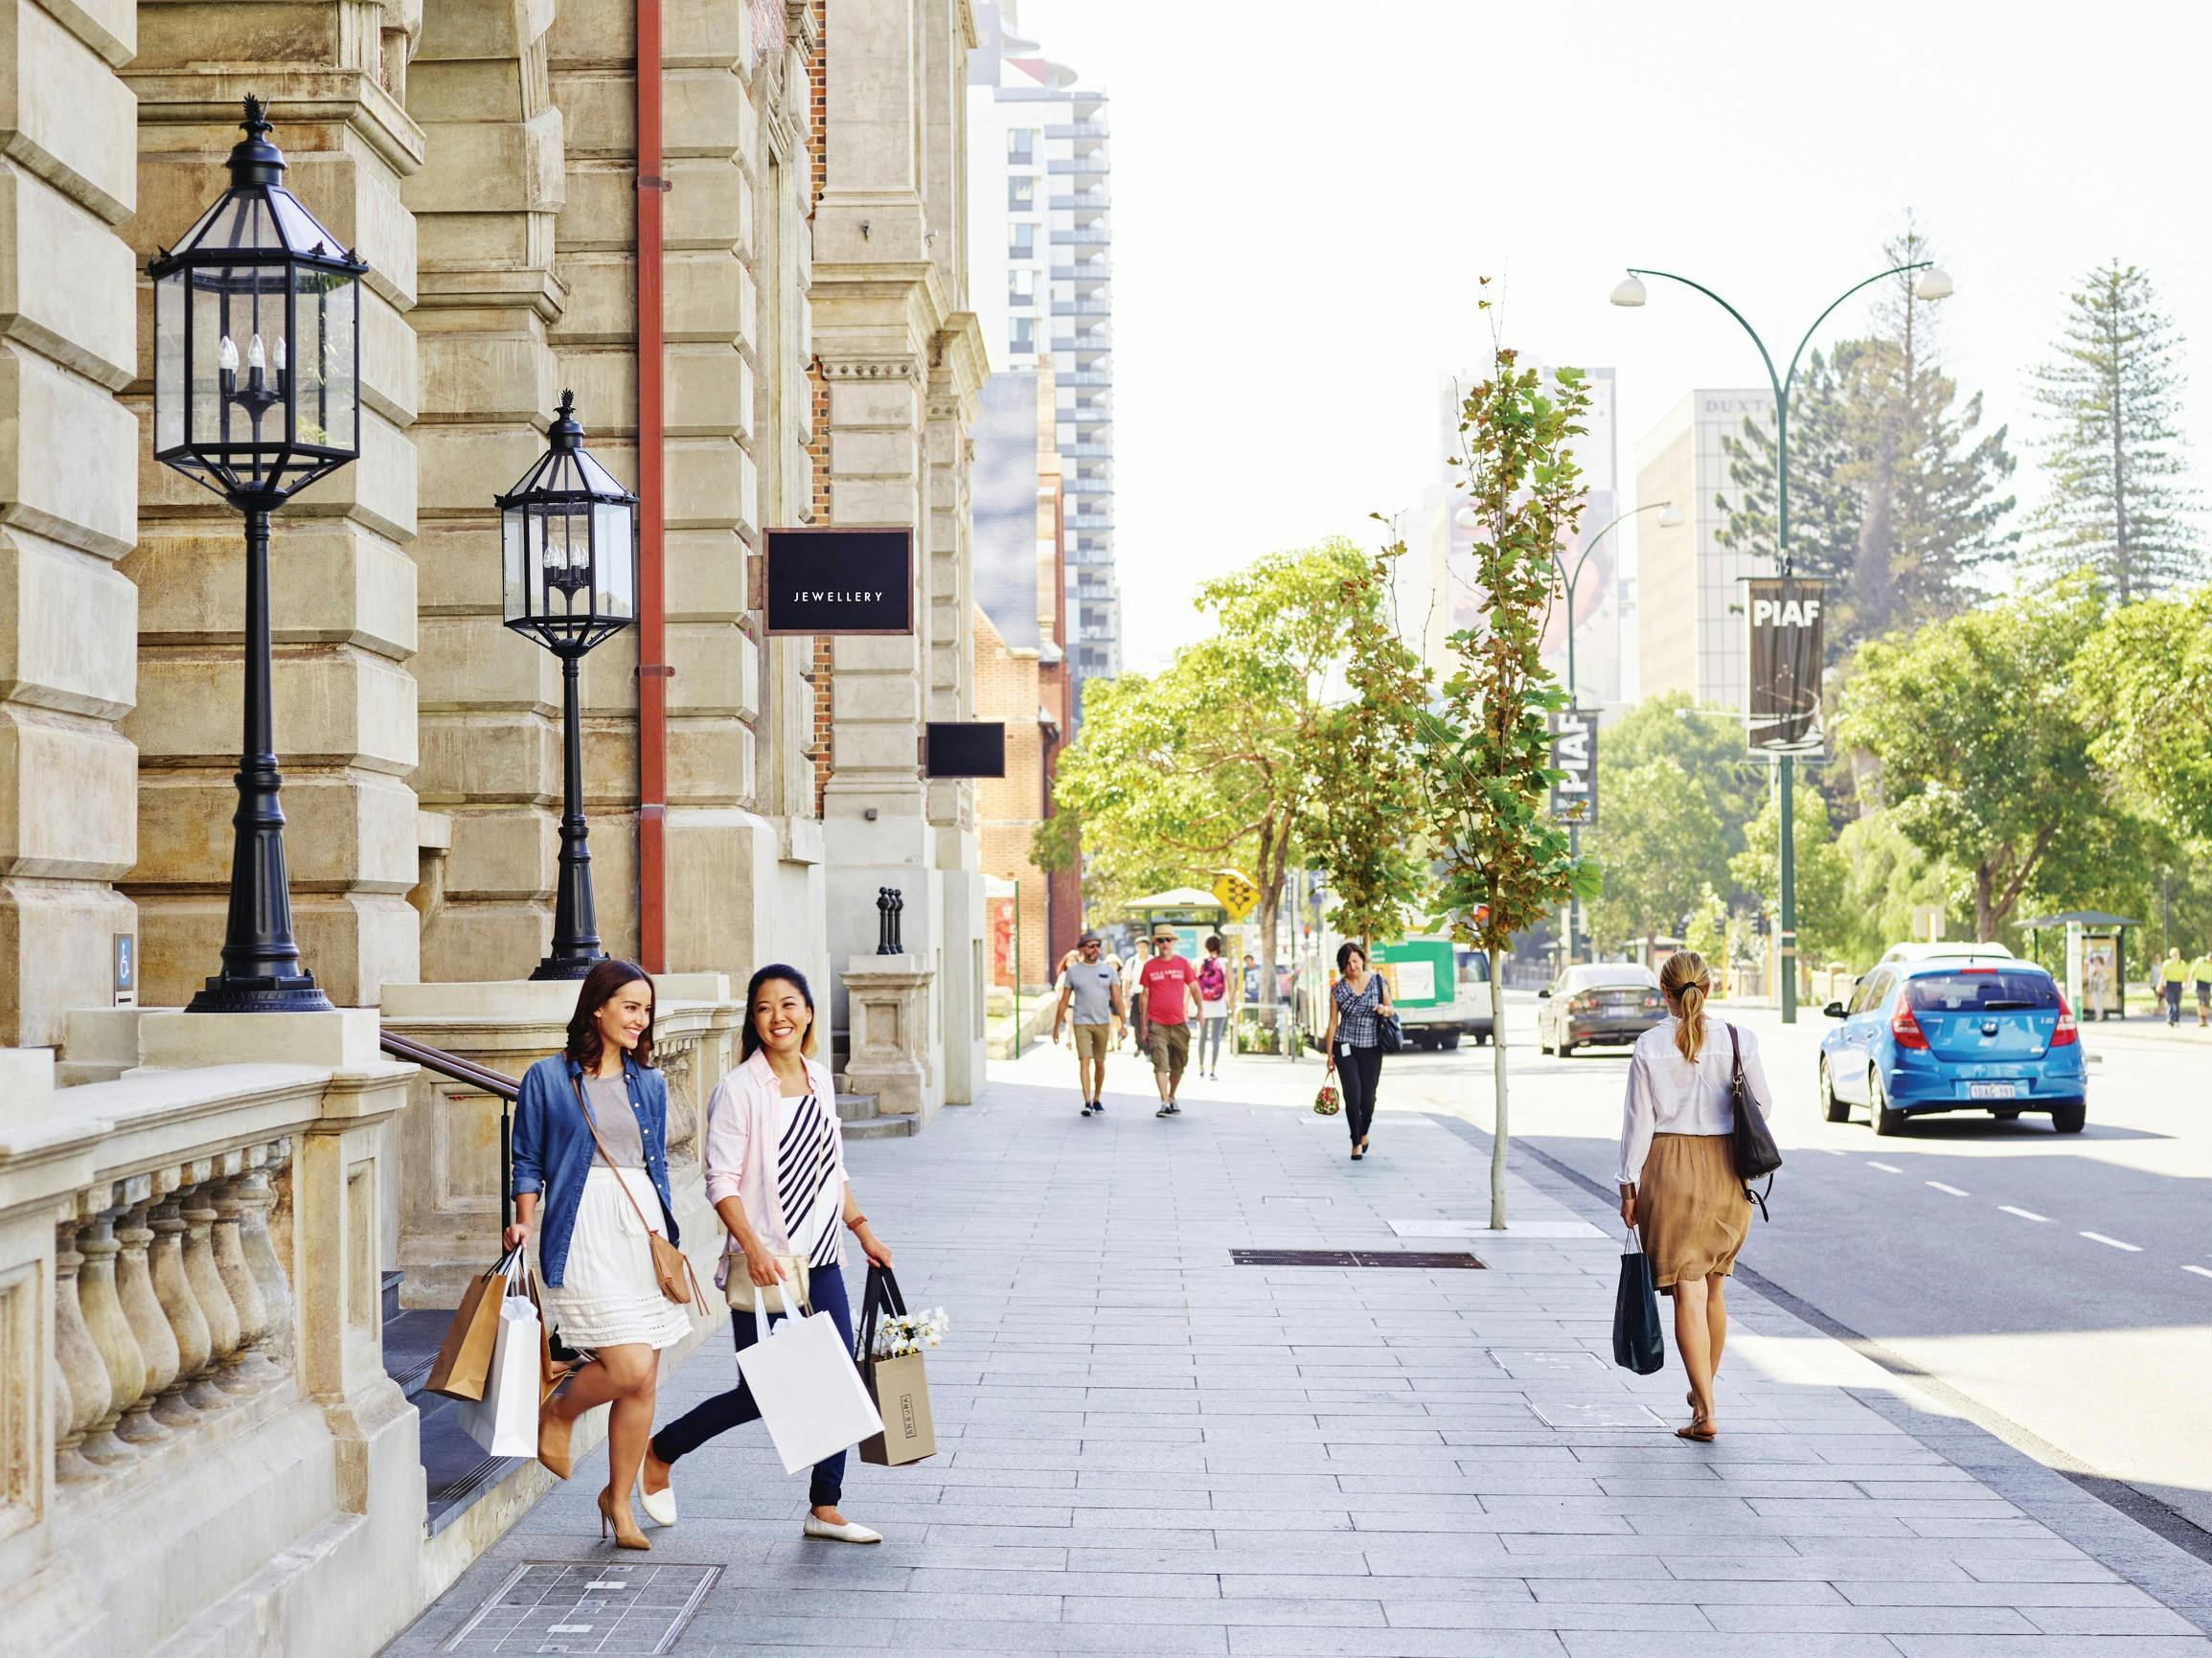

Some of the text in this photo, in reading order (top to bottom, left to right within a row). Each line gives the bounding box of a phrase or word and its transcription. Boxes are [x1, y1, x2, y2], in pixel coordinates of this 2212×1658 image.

[793, 591, 882, 602] JEWELLERY
[1752, 599, 1821, 628] PIAF
[1558, 713, 1590, 793] PIAF
